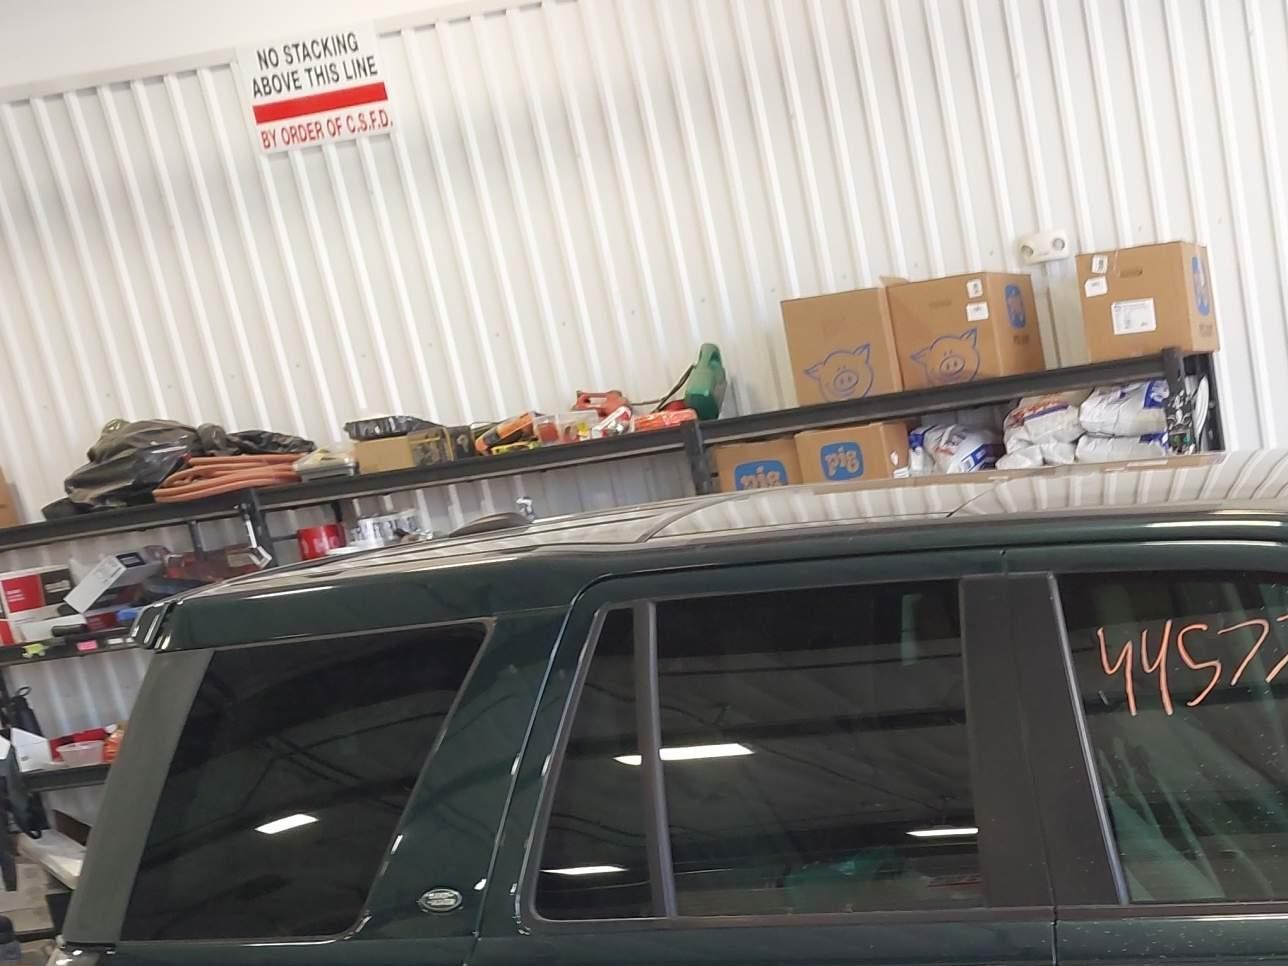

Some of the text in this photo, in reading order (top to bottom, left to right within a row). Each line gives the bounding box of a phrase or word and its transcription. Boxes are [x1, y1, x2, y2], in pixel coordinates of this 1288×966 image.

[257, 32, 359, 70] NO STACKING
[252, 56, 378, 98] ABOVE THIS LINE
[261, 109, 394, 149] BY ORDER OF C.S.F.D.
